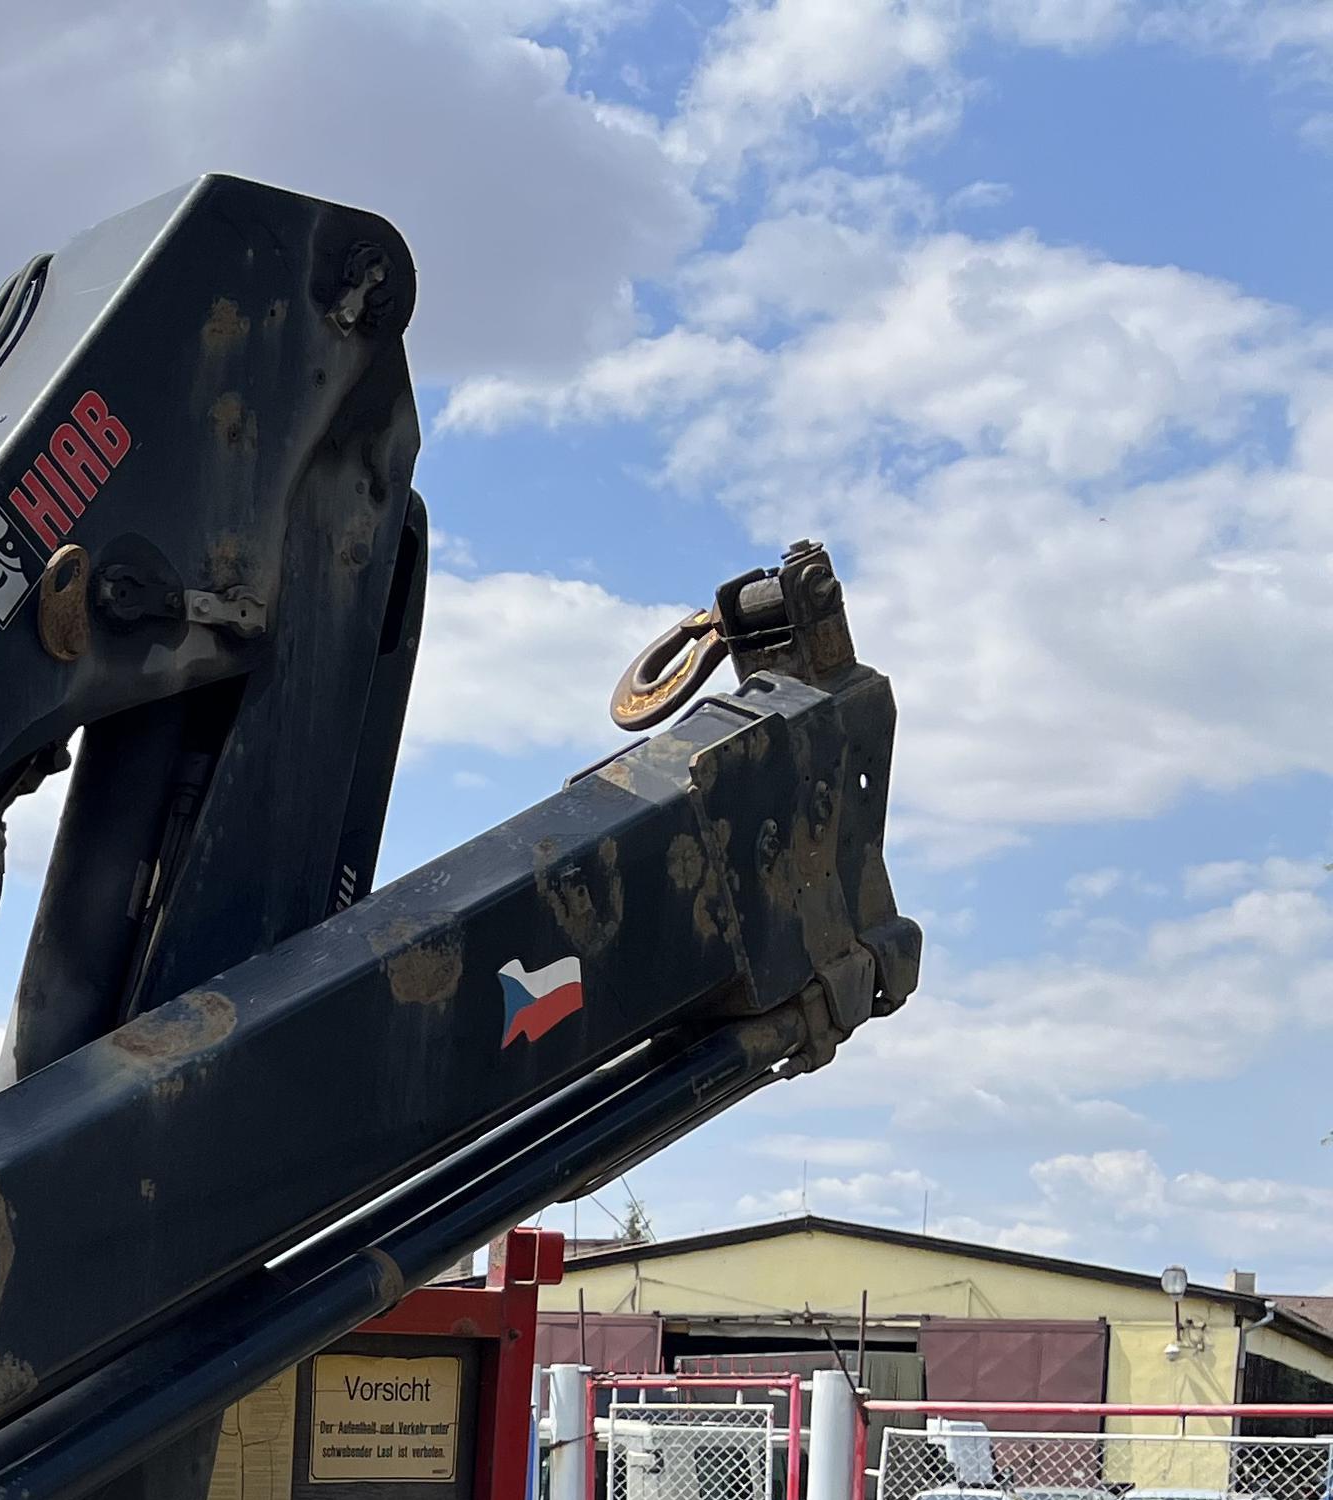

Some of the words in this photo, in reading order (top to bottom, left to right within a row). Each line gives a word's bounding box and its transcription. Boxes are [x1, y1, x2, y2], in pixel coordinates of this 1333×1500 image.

[8, 390, 131, 552] HIAB
[344, 1375, 432, 1402] Vorsicht
[320, 1420, 333, 1435] Der
[380, 1422, 395, 1435] und
[398, 1421, 428, 1435] Verkehr
[322, 1444, 373, 1458] schwebender
[376, 1445, 394, 1458] Last
[398, 1445, 408, 1458] ist
